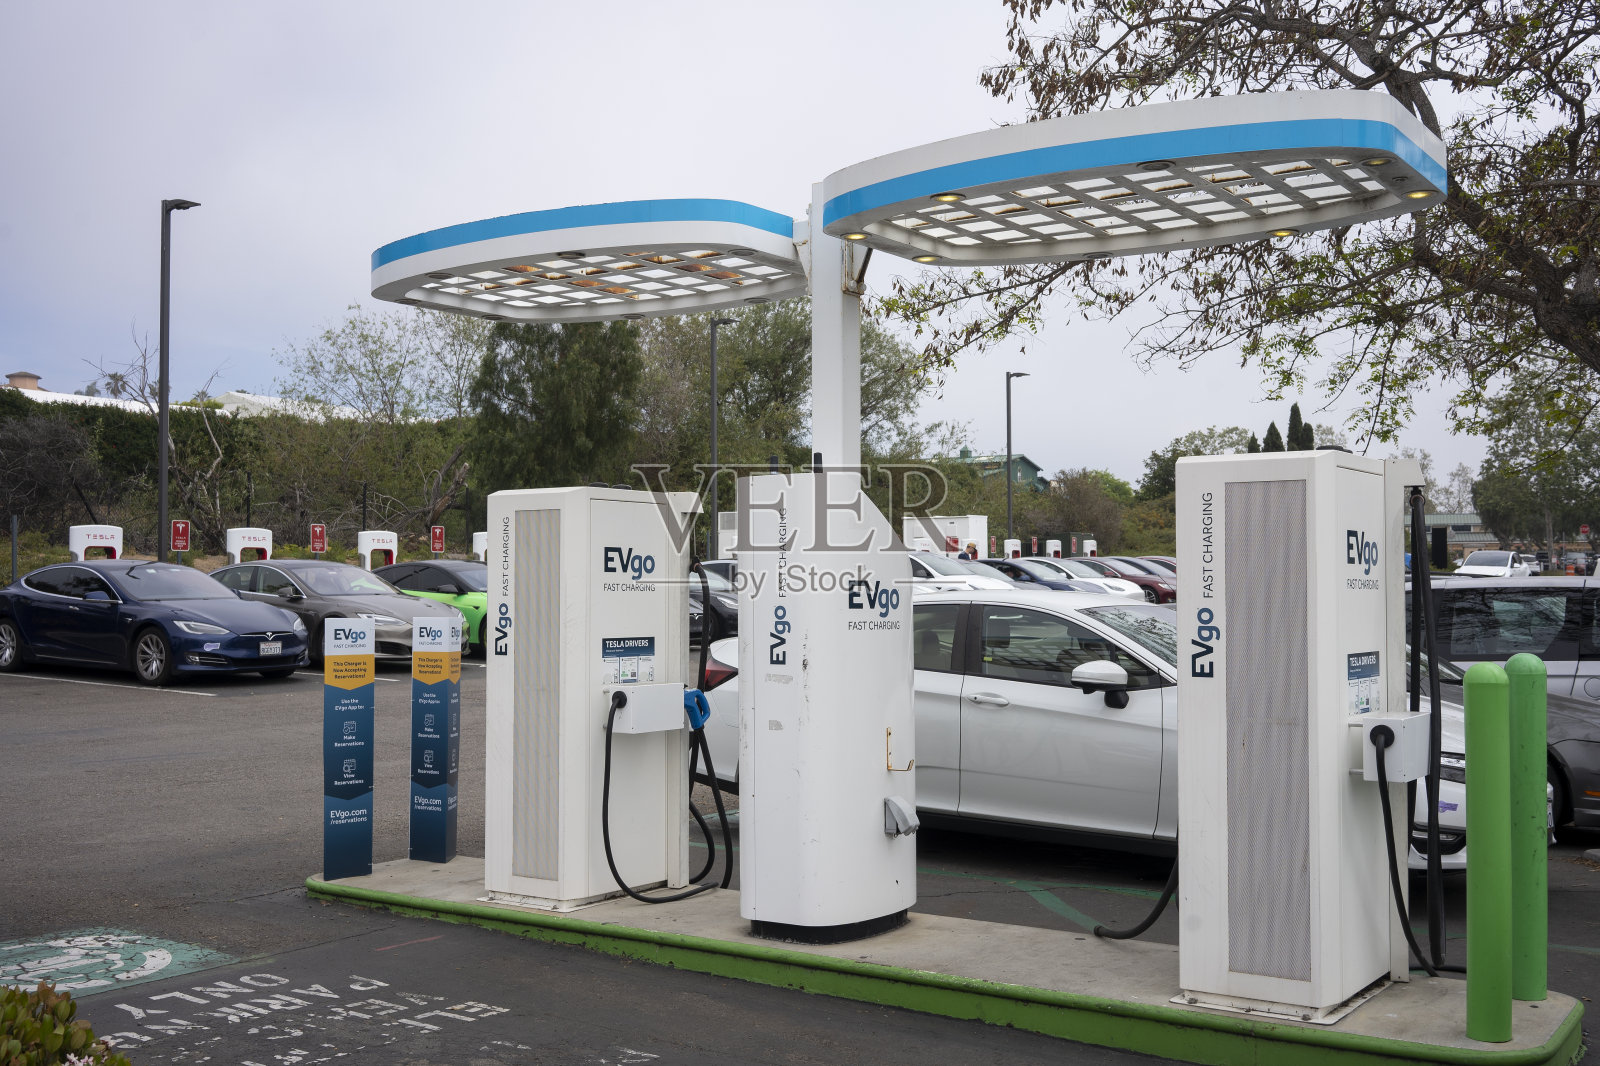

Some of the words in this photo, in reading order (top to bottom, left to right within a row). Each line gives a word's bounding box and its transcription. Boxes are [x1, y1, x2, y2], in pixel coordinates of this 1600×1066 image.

[779, 508, 787, 568] CHARGING
[1202, 492, 1214, 563] CHARGING
[502, 516, 510, 570] CHARGING
[1346, 529, 1379, 576] EVgo
[604, 546, 656, 581] EVgo
[603, 583, 620, 592] FAST
[620, 583, 656, 592] CHARGING
[779, 571, 787, 598] FAST
[1203, 567, 1214, 598] FAST
[1346, 578, 1358, 590] FAST
[1358, 578, 1379, 590] CHARGING
[848, 579, 900, 618] EVgo
[334, 628, 366, 643] EVgo
[418, 626, 443, 641] EVgo
[494, 602, 512, 656] EVgo
[769, 605, 791, 665] EVgo
[848, 621, 867, 631] FAST
[868, 620, 901, 631] CHARGING
[605, 640, 625, 648] TESLA
[625, 639, 649, 647] DRIVERS
[1191, 607, 1221, 678] EVgo
[1349, 656, 1361, 666] TESLA
[1361, 655, 1377, 665] DRIVERS
[330, 809, 367, 819] EVgo.com
[414, 795, 442, 805] EVgo.com
[331, 816, 368, 825] /reservations
[114, 973, 290, 1020] ONLY
